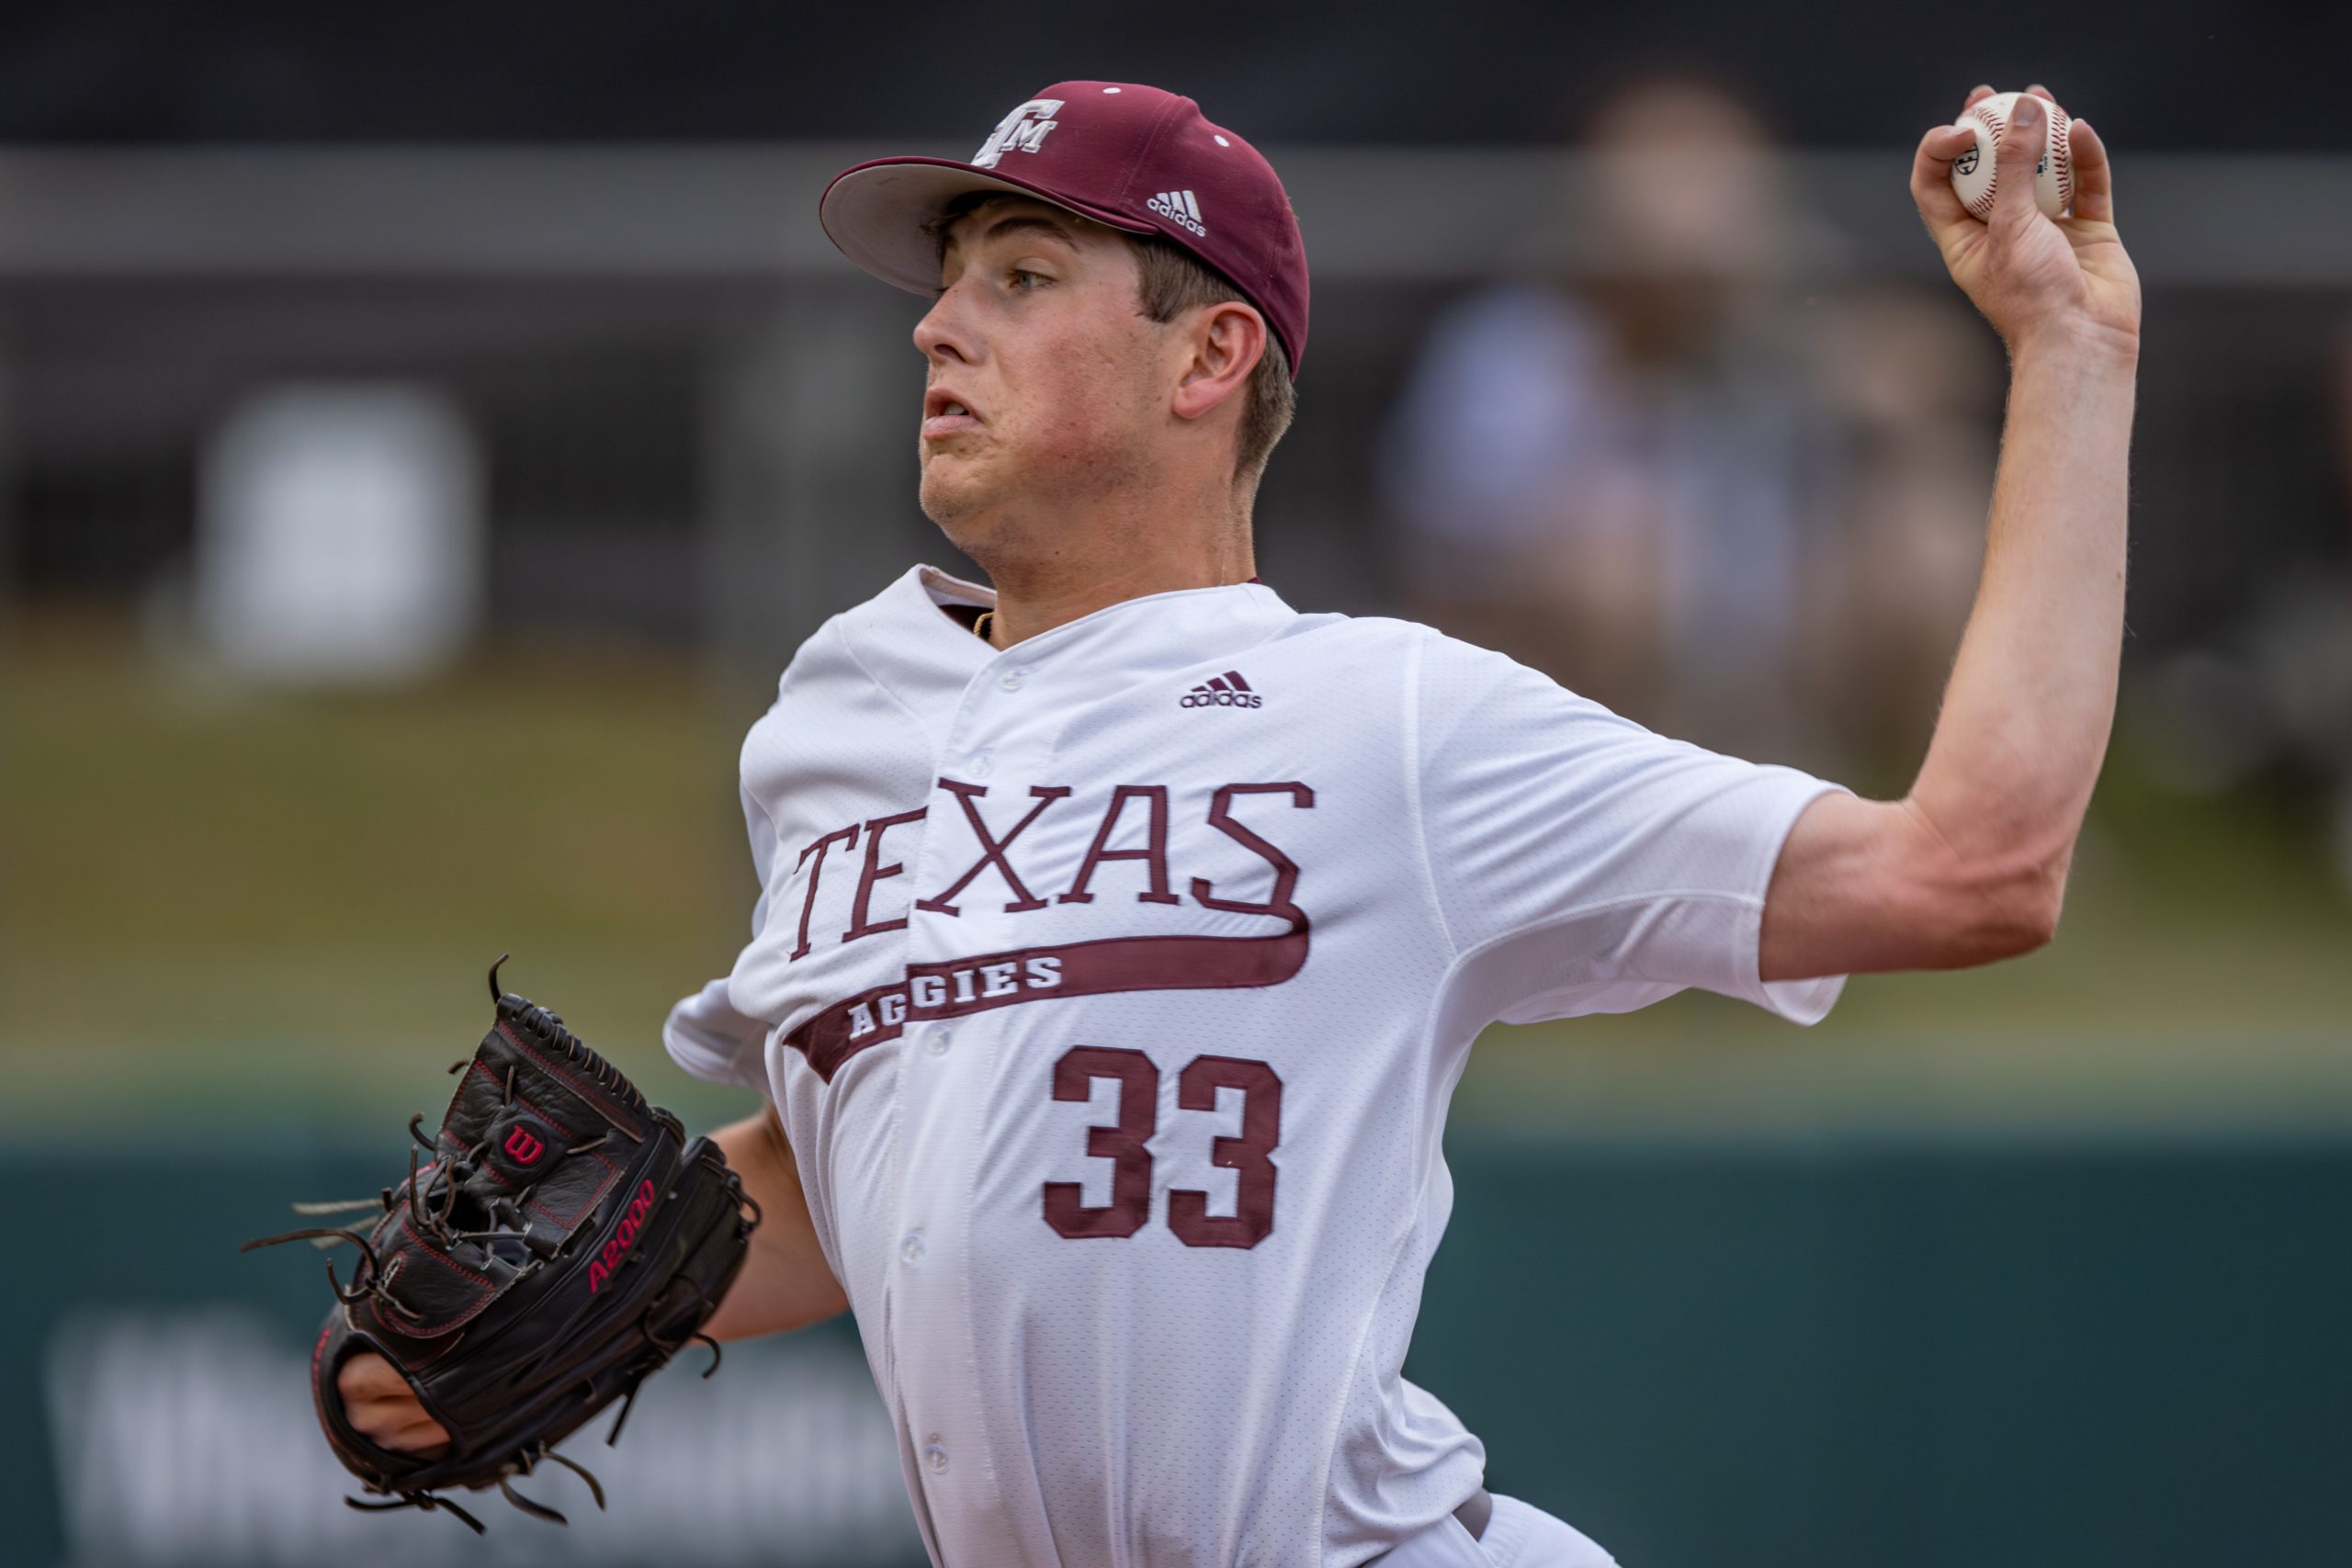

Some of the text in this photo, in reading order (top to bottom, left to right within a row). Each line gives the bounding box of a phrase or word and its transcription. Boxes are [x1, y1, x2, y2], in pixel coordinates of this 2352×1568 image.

[1147, 197, 1205, 237] adidas
[1180, 690, 1262, 708] adidas
[789, 777, 1315, 963] TEXAS
[848, 956, 1062, 1040] AGGIES
[504, 1124, 544, 1165] W
[1043, 1045, 1283, 1249] 33
[589, 1179, 655, 1294] A2000
